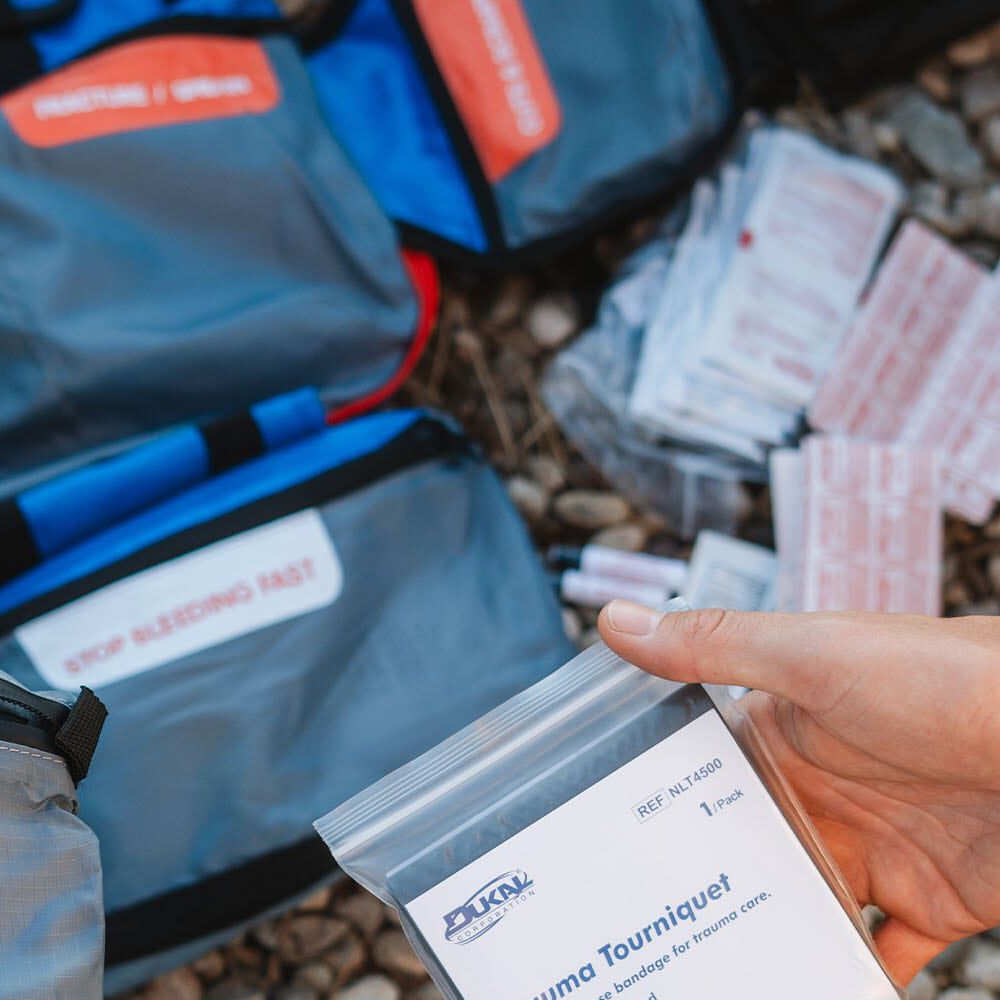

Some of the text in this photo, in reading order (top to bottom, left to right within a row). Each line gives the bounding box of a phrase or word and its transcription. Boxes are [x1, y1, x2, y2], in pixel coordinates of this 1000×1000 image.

[64, 558, 315, 674] STOP BLEEDING FAST
[637, 758, 723, 818] REF NLT4500
[443, 875, 533, 938] DUKAL
[457, 890, 535, 941] CORPORATION
[598, 873, 731, 967] Tourniquet
[614, 953, 670, 994] bandage
[672, 940, 691, 959] for
[692, 910, 738, 944] trauma
[740, 892, 772, 913] care.
